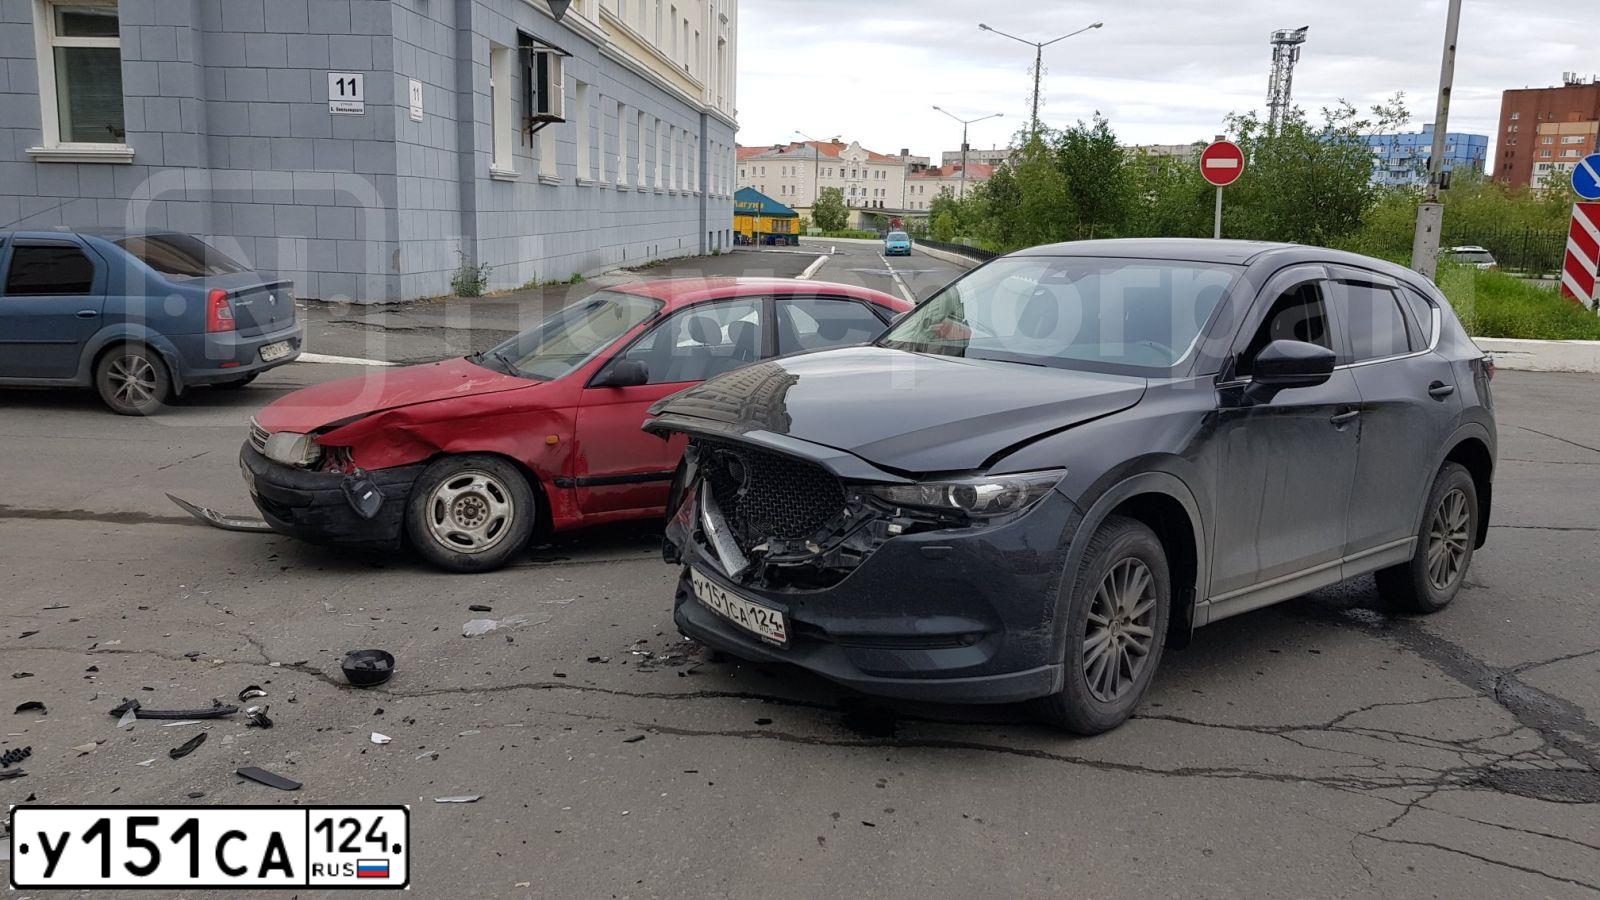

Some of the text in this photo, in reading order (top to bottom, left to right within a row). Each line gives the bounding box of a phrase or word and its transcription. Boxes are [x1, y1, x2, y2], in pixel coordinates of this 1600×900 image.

[336, 78, 356, 96] 11
[696, 580, 780, 632] У151СА 124
